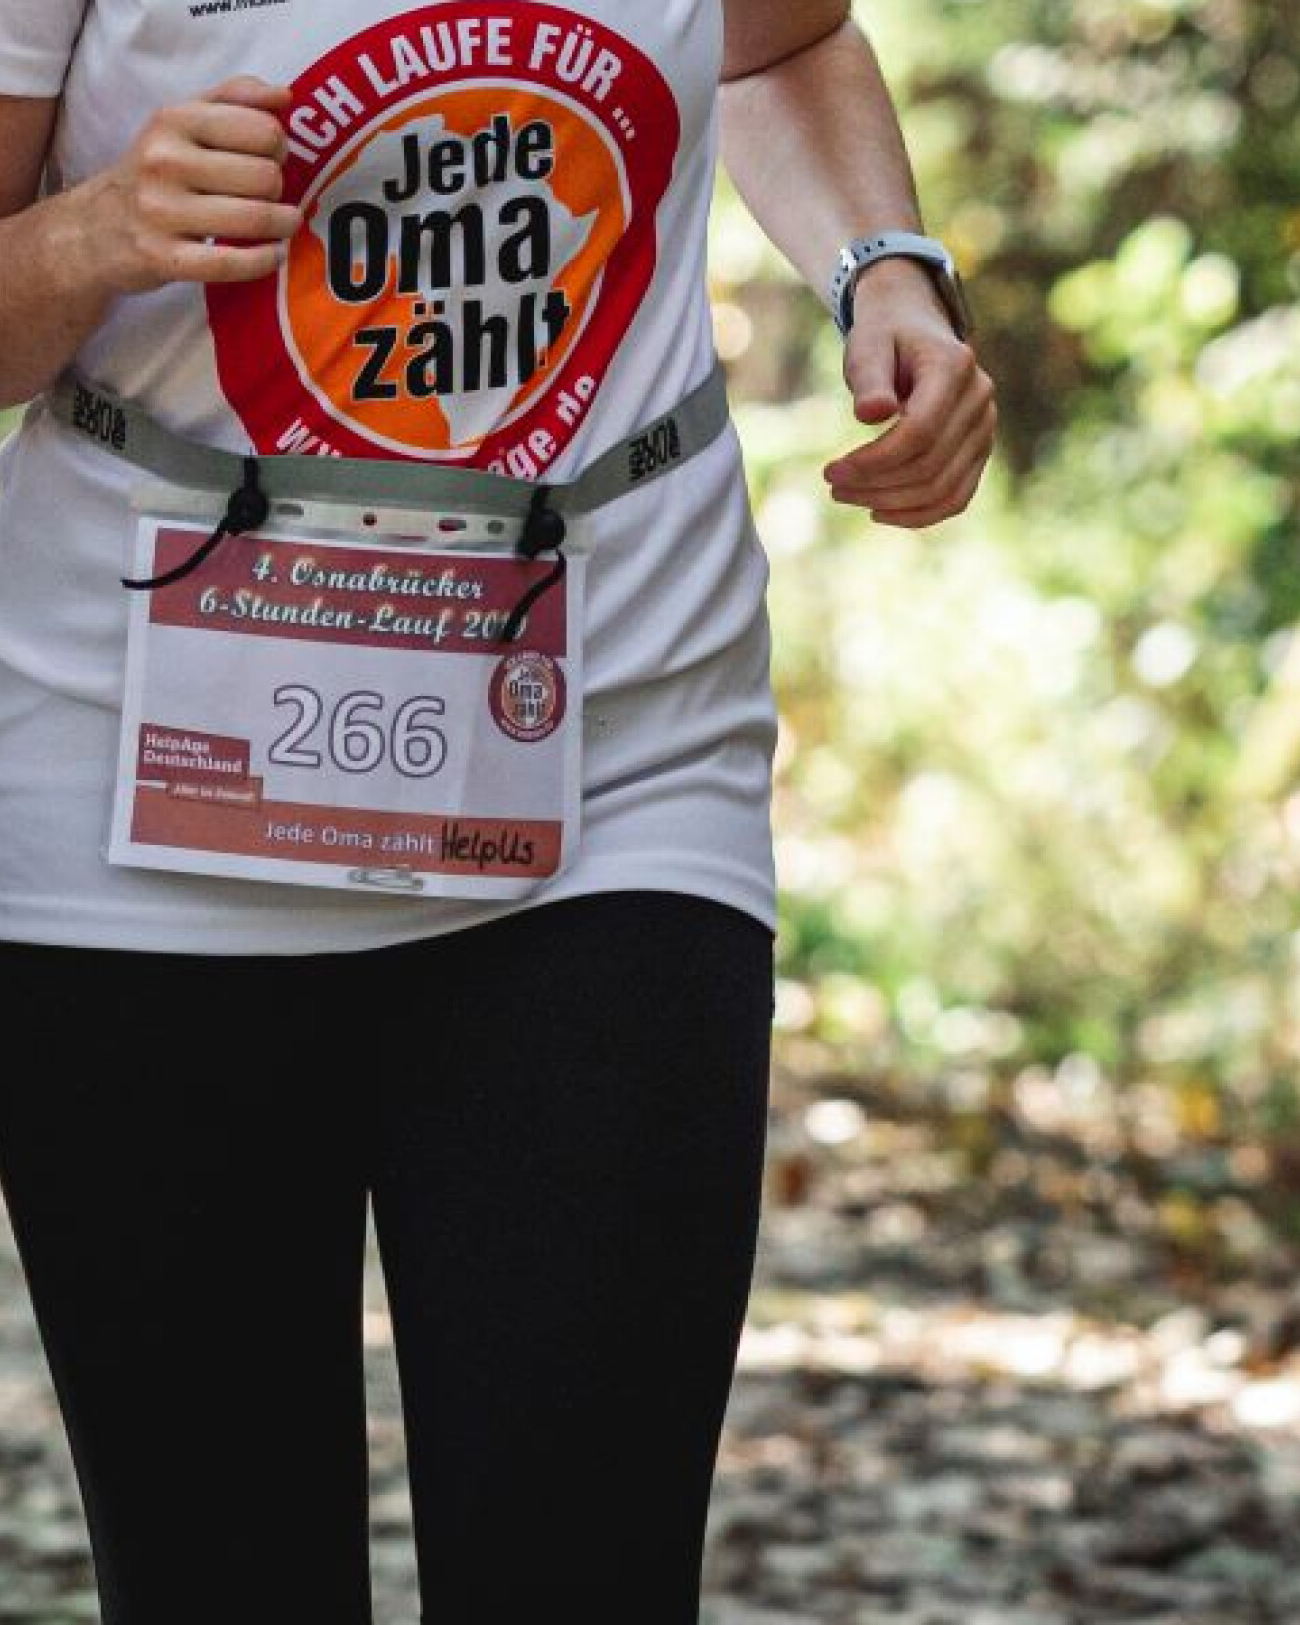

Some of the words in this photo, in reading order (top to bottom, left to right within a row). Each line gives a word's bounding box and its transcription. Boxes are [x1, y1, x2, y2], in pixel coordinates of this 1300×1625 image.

[287, 75, 365, 164] ICH
[357, 18, 512, 98] LAUFE
[382, 115, 554, 204] Jede
[327, 195, 550, 302] Oma
[352, 290, 571, 400] zählt
[199, 584, 454, 644] 6-Stunden-Lauf
[252, 552, 279, 583] 4.
[290, 554, 485, 600] Osnabrücker
[268, 684, 448, 779] 266
[265, 821, 314, 844] Jede
[321, 825, 373, 850] Oma
